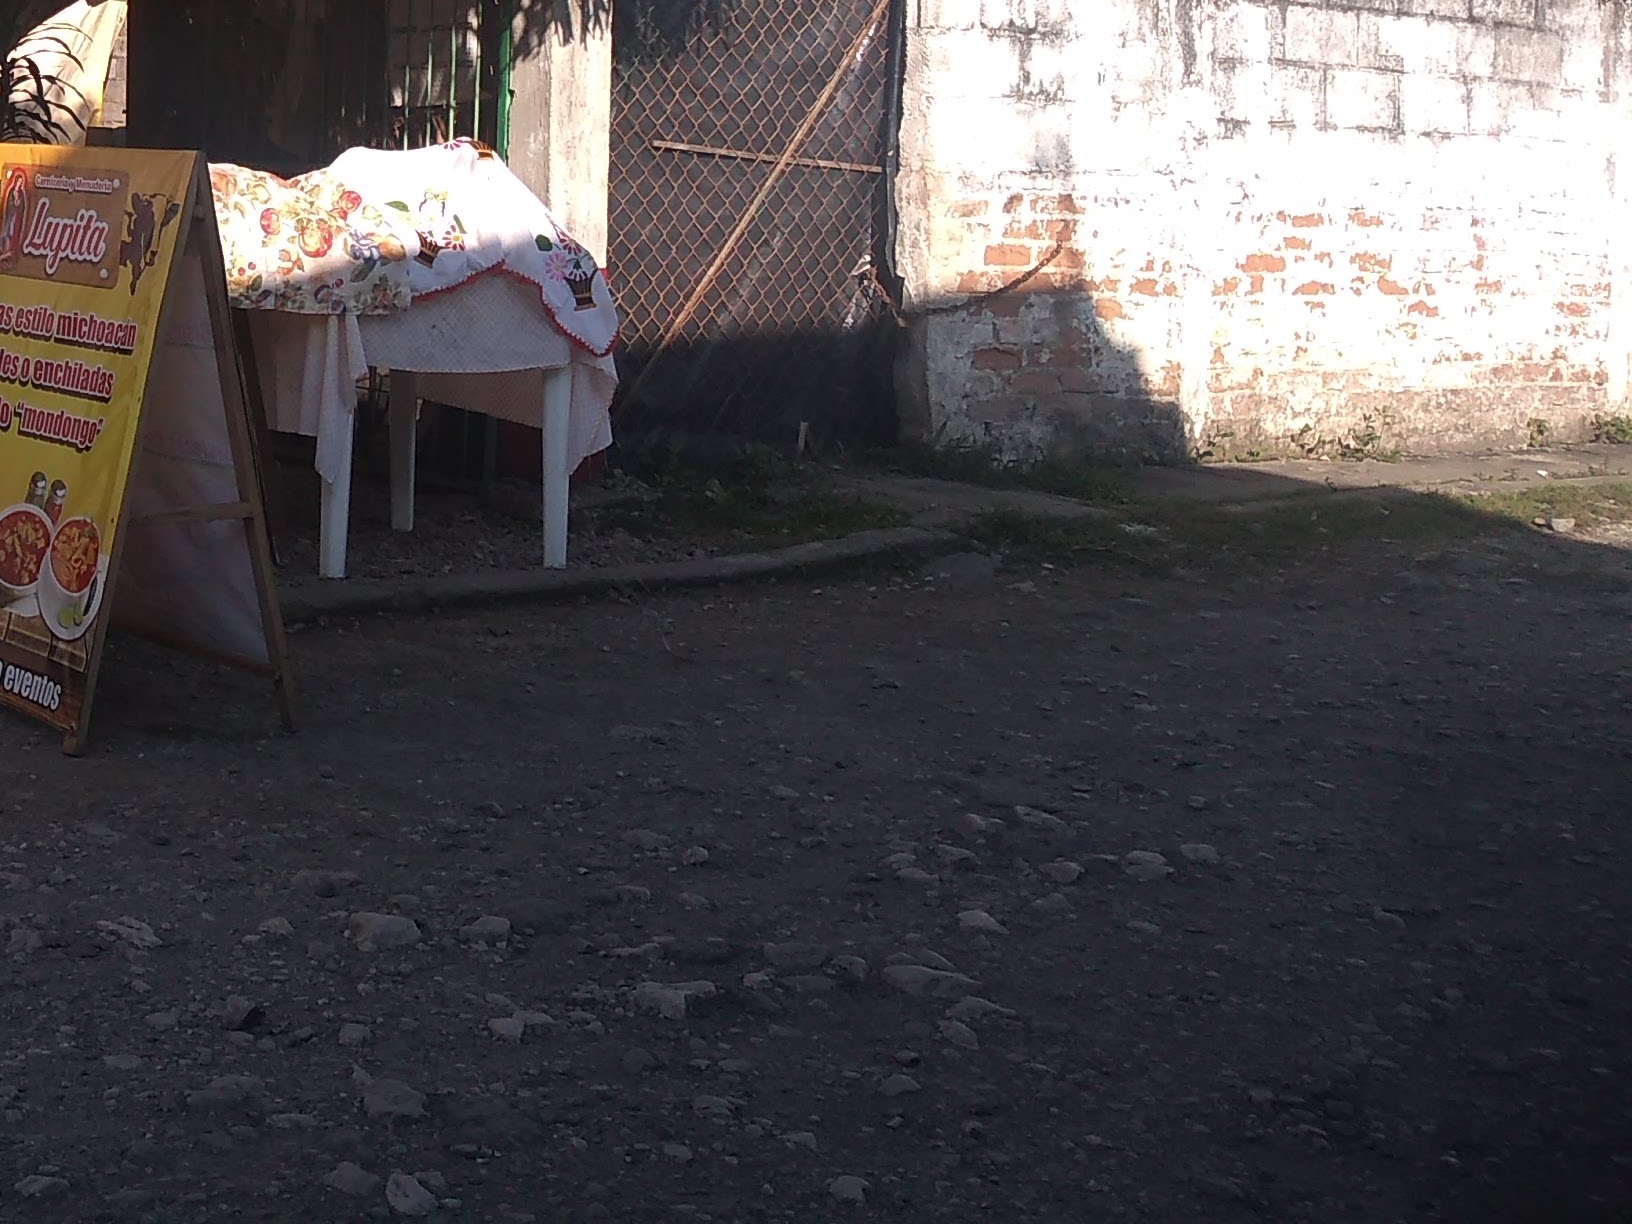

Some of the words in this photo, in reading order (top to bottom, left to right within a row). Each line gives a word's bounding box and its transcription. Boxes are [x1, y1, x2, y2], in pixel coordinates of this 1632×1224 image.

[22, 197, 110, 274] Lupita
[14, 306, 55, 336] estilo
[19, 357, 32, 380] o
[33, 358, 114, 398] enchiladas
[3, 664, 63, 711] eventos
